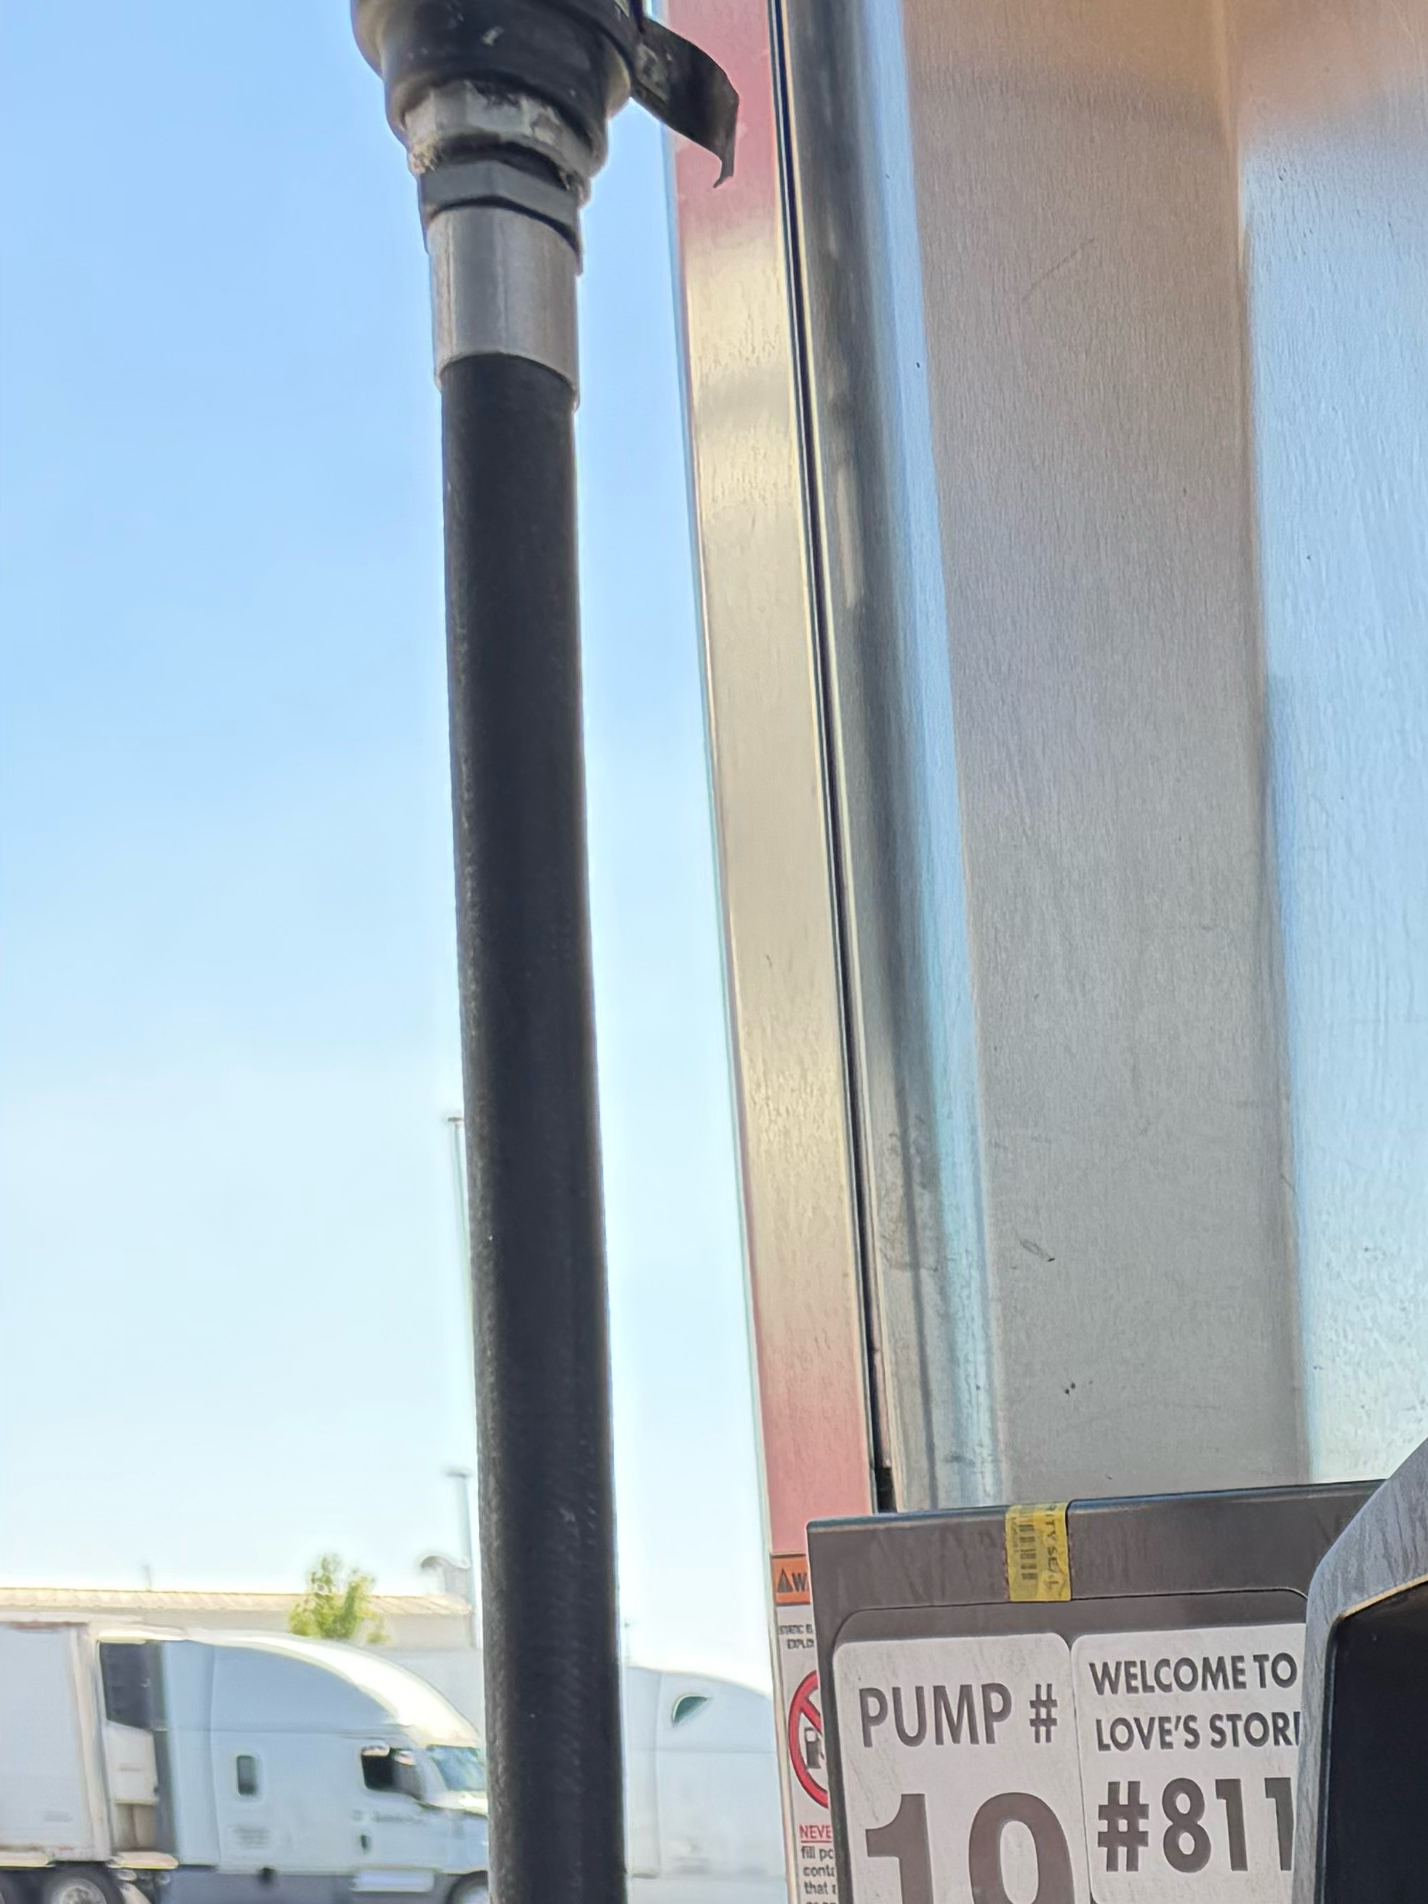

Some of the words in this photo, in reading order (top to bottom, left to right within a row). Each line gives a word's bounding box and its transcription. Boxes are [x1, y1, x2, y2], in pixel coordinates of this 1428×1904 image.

[1088, 1653, 1247, 1696] WELCOME
[1253, 1652, 1298, 1690] TO
[859, 1683, 1012, 1748] PUMP
[1028, 1683, 1058, 1744] #
[1094, 1714, 1201, 1752] LOVE'S
[1097, 1777, 1294, 1874] #811
